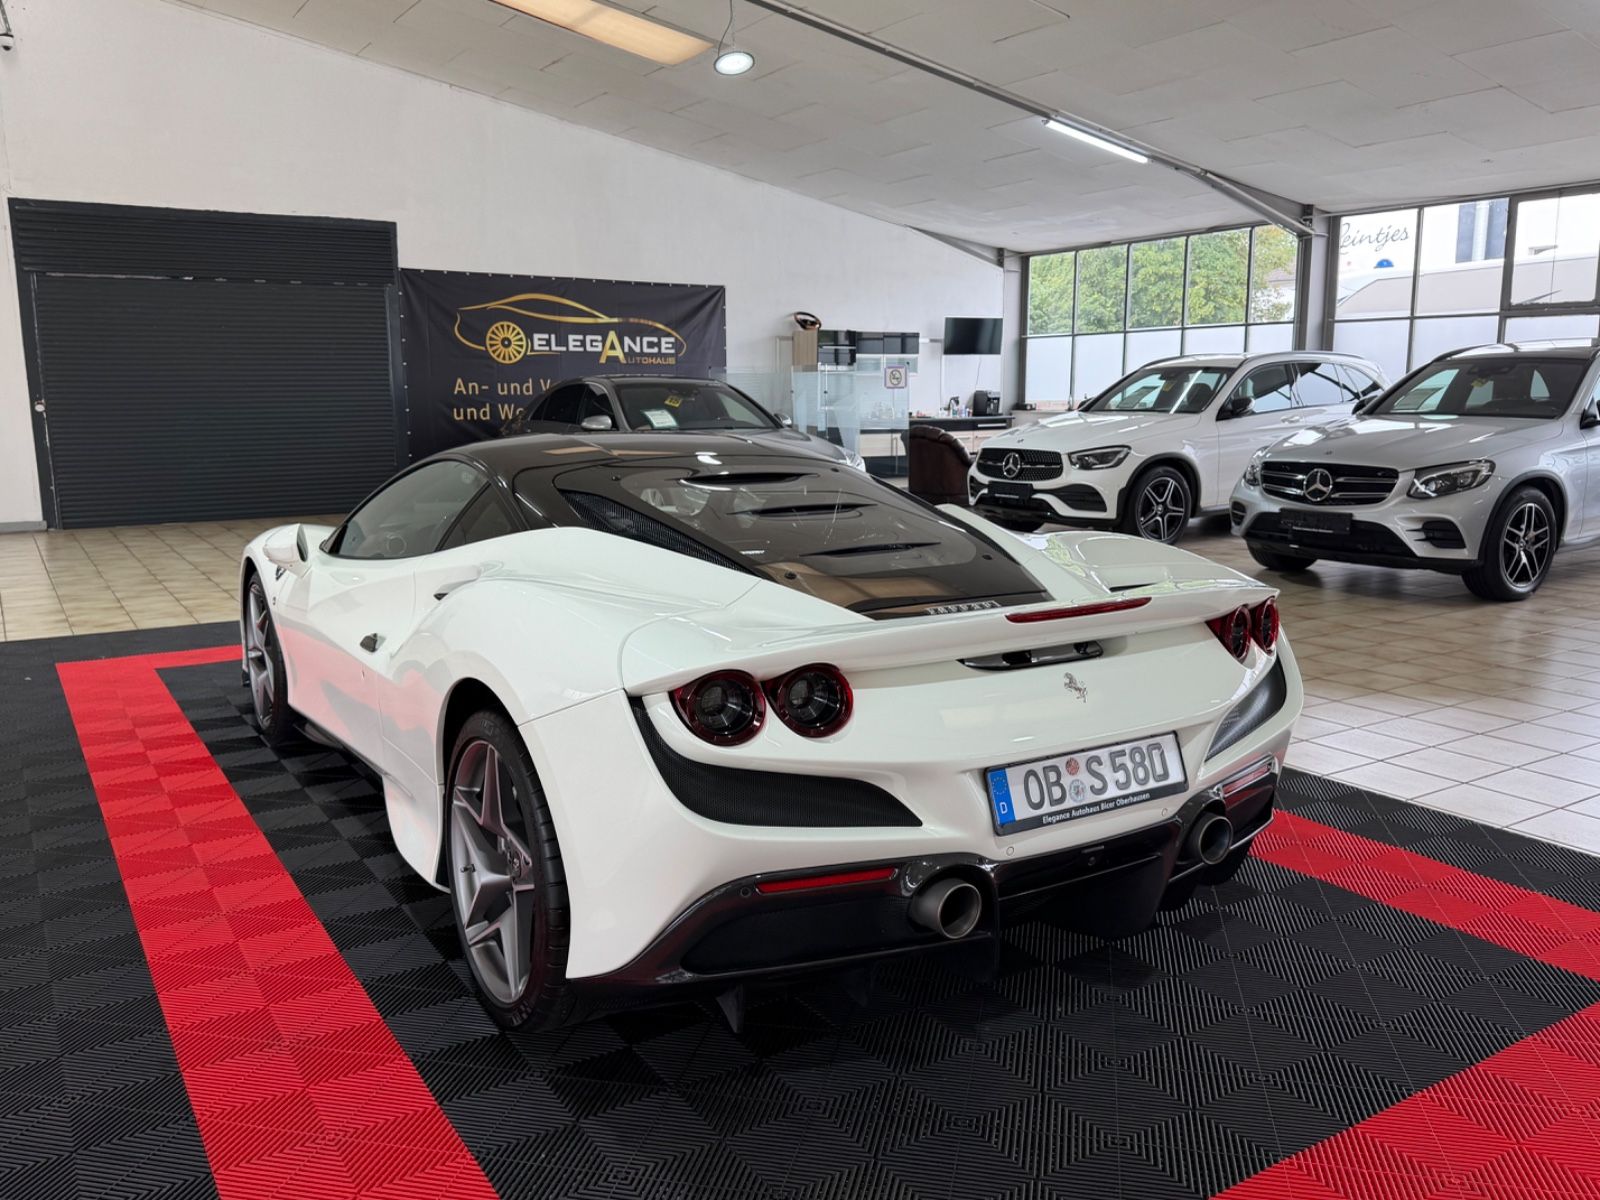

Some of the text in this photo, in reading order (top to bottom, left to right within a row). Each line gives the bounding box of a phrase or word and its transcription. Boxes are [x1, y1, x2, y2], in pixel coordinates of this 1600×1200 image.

[532, 330, 676, 364] ELEGANCE
[453, 377, 489, 395] An-
[497, 377, 533, 395] und
[453, 403, 491, 420] und
[1023, 764, 1067, 811] OB
[1000, 802, 1008, 814] D
[1042, 811, 1070, 824] Elegance
[1072, 805, 1100, 817] Autohaus
[1116, 792, 1151, 806] Oberhausen
